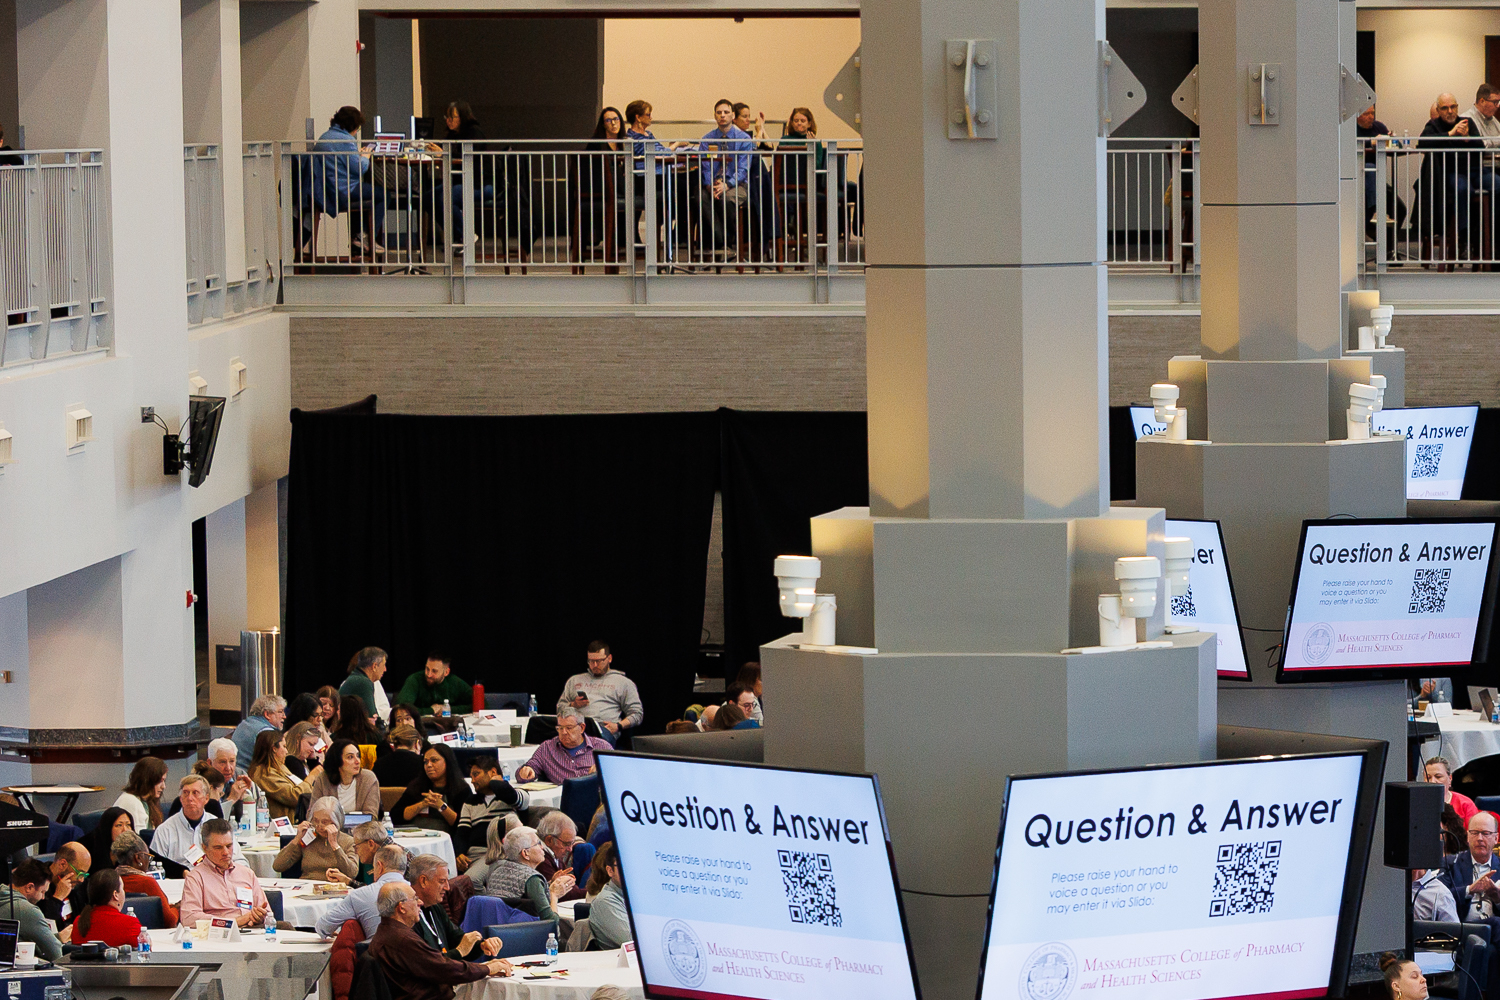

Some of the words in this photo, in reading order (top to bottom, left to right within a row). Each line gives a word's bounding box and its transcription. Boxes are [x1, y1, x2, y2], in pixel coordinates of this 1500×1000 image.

[1419, 424, 1469, 439] Answer
[1309, 542, 1393, 565] Question
[1399, 543, 1410, 561] &
[1416, 541, 1486, 561] Answer
[621, 790, 736, 832] Question
[744, 804, 763, 835] &
[773, 805, 869, 845] Answer
[1025, 806, 1175, 848] Question
[1188, 804, 1208, 834] &
[1220, 799, 1342, 832] Answer
[655, 851, 680, 863] Please
[682, 854, 700, 865] raise
[701, 859, 718, 867] your
[720, 858, 741, 869] hand
[743, 860, 751, 870] to
[658, 867, 679, 877] voice
[682, 870, 687, 878] a
[689, 871, 722, 882] question
[724, 875, 731, 883] or
[733, 876, 748, 886] you
[1051, 873, 1084, 883] Please
[1087, 869, 1110, 880] raise
[1114, 868, 1136, 880] your
[1138, 864, 1165, 876] hand
[1168, 864, 1178, 873] to
[1049, 888, 1077, 898] voice
[1080, 888, 1087, 896] a
[1091, 883, 1133, 897] question
[1137, 883, 1147, 891] or
[1149, 882, 1168, 892] you
[1046, 905, 1070, 915] may
[1073, 901, 1100, 912] enter
[1102, 899, 1108, 909] it
[1111, 898, 1125, 908] via
[1128, 897, 1155, 907] Slido:
[1083, 954, 1176, 972] MASSACHUSETTS
[1180, 949, 1230, 963] COLLEGE
[1233, 948, 1243, 961] of
[1246, 942, 1305, 957] PHARMACY
[1081, 978, 1099, 990] and
[1100, 973, 1146, 989] HEALTH
[1150, 969, 1202, 983] SCIENCES
